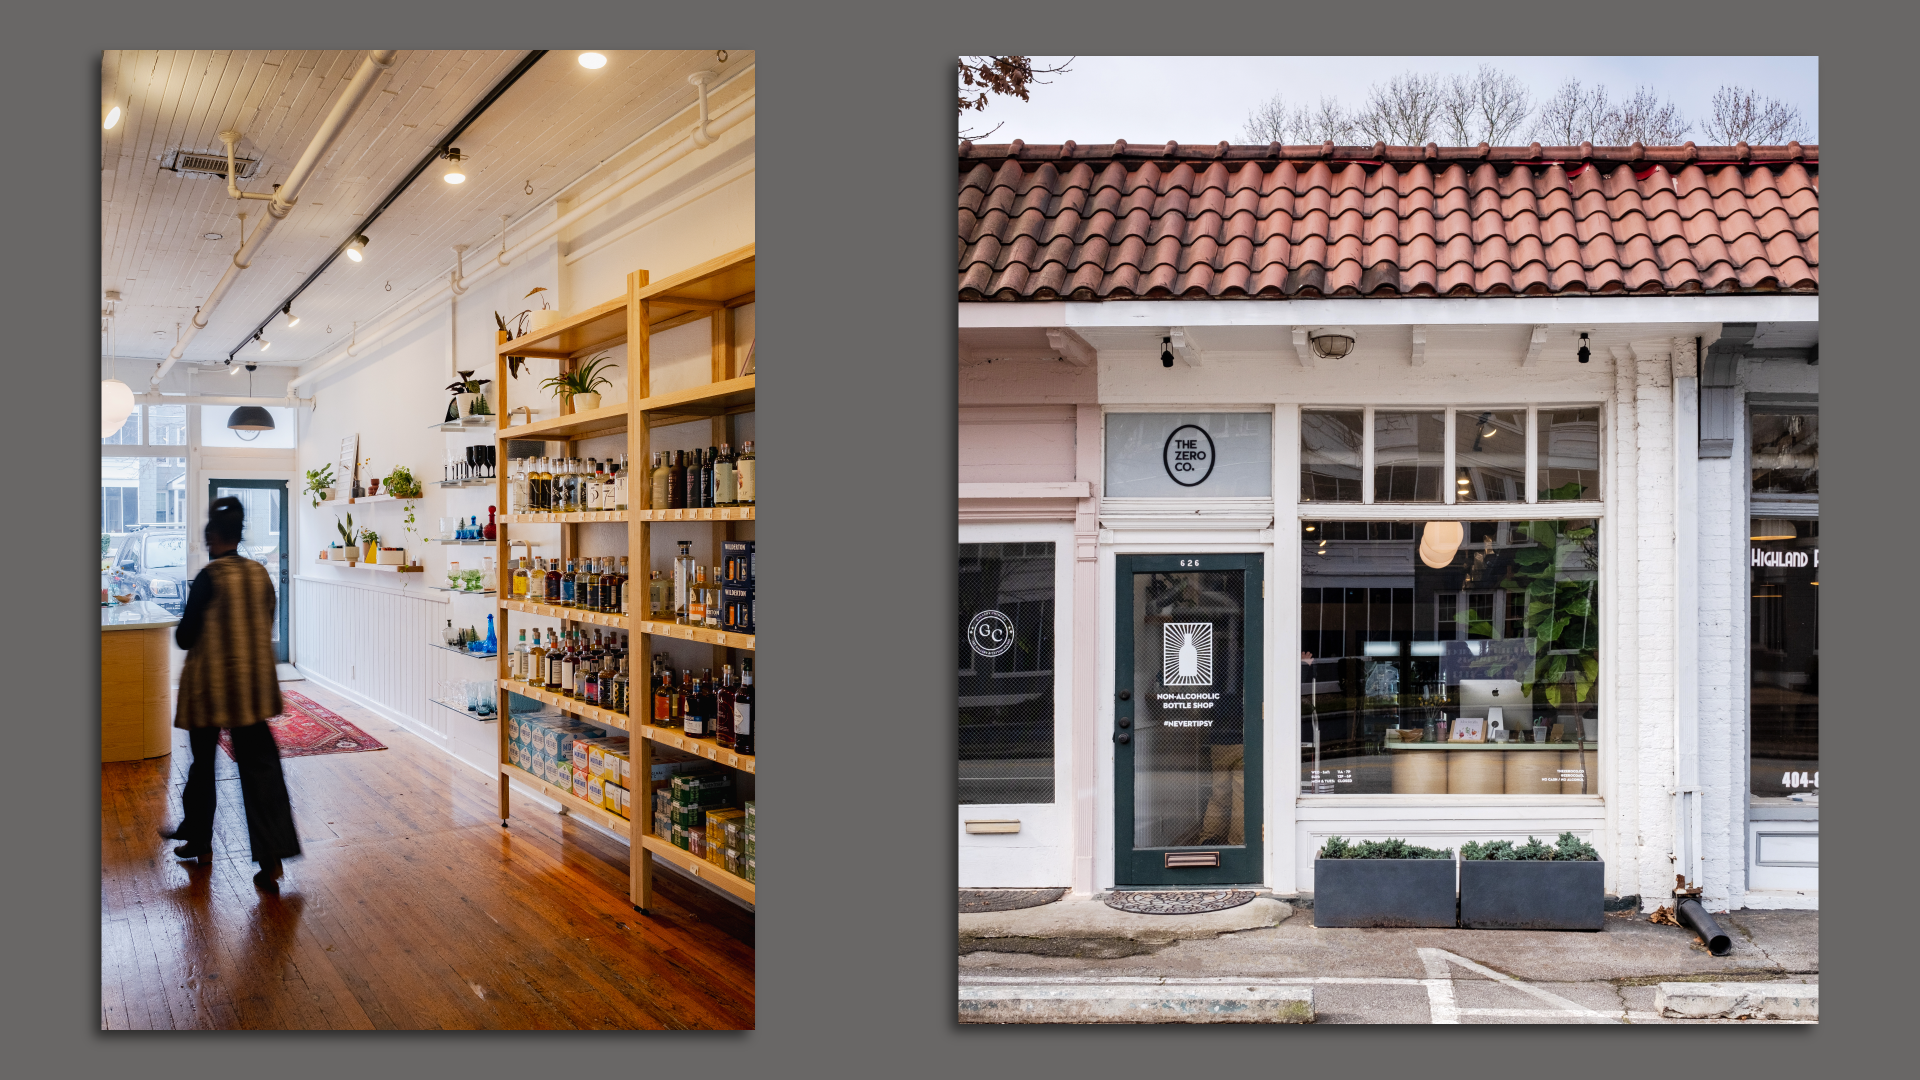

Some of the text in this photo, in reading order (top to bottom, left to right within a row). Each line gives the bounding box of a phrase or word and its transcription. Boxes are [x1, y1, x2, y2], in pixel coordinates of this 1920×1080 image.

[1174, 440, 1198, 449] THE
[1174, 451, 1206, 460] ZERO
[1174, 462, 1194, 472] CO.
